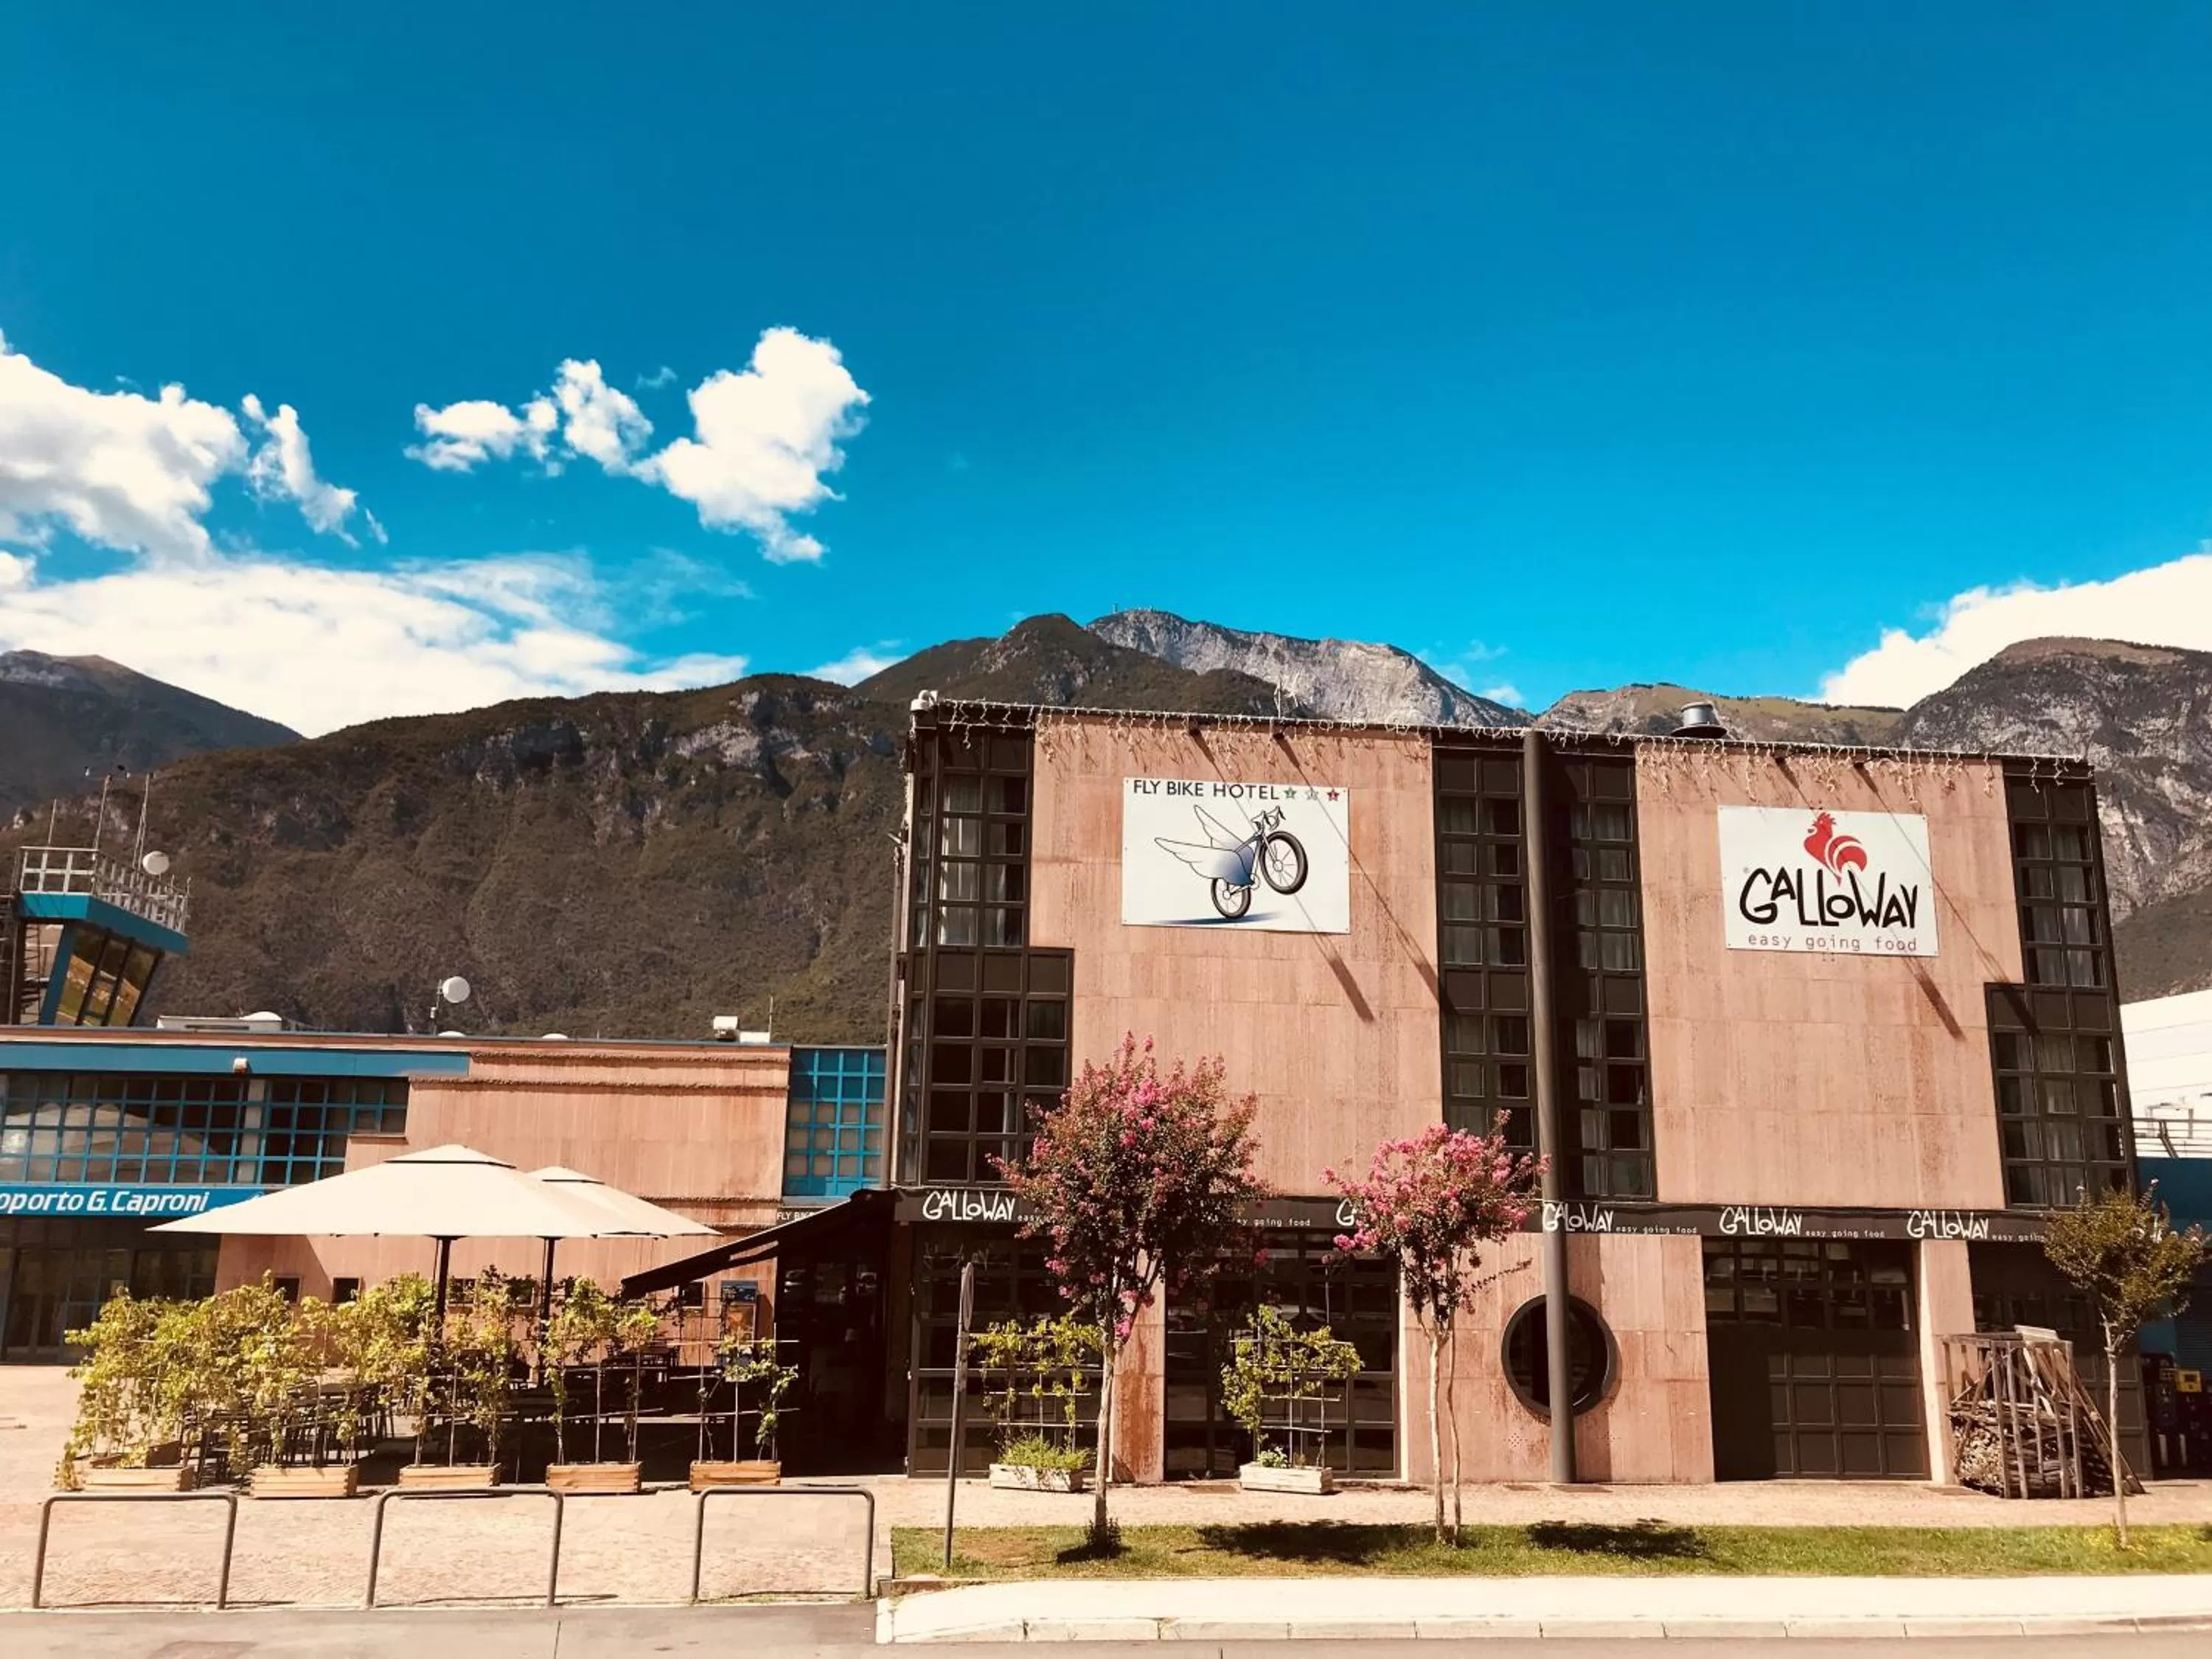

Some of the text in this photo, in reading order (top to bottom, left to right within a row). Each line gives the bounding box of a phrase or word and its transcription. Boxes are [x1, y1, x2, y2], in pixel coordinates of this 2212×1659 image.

[1133, 780, 1279, 800] FLY BIKE HOTEL
[1739, 866, 1918, 929] GALLOWAY
[1748, 934, 1917, 951] easy going food
[111, 1191, 210, 1215] Caproni
[922, 1190, 1016, 1221] GALLOWAY
[776, 1211, 791, 1220] FLY
[1719, 1206, 1885, 1239] GALLOWAY easy going food
[1907, 1210, 1989, 1239] GALLOWAY
[1643, 1225, 1671, 1234] going
